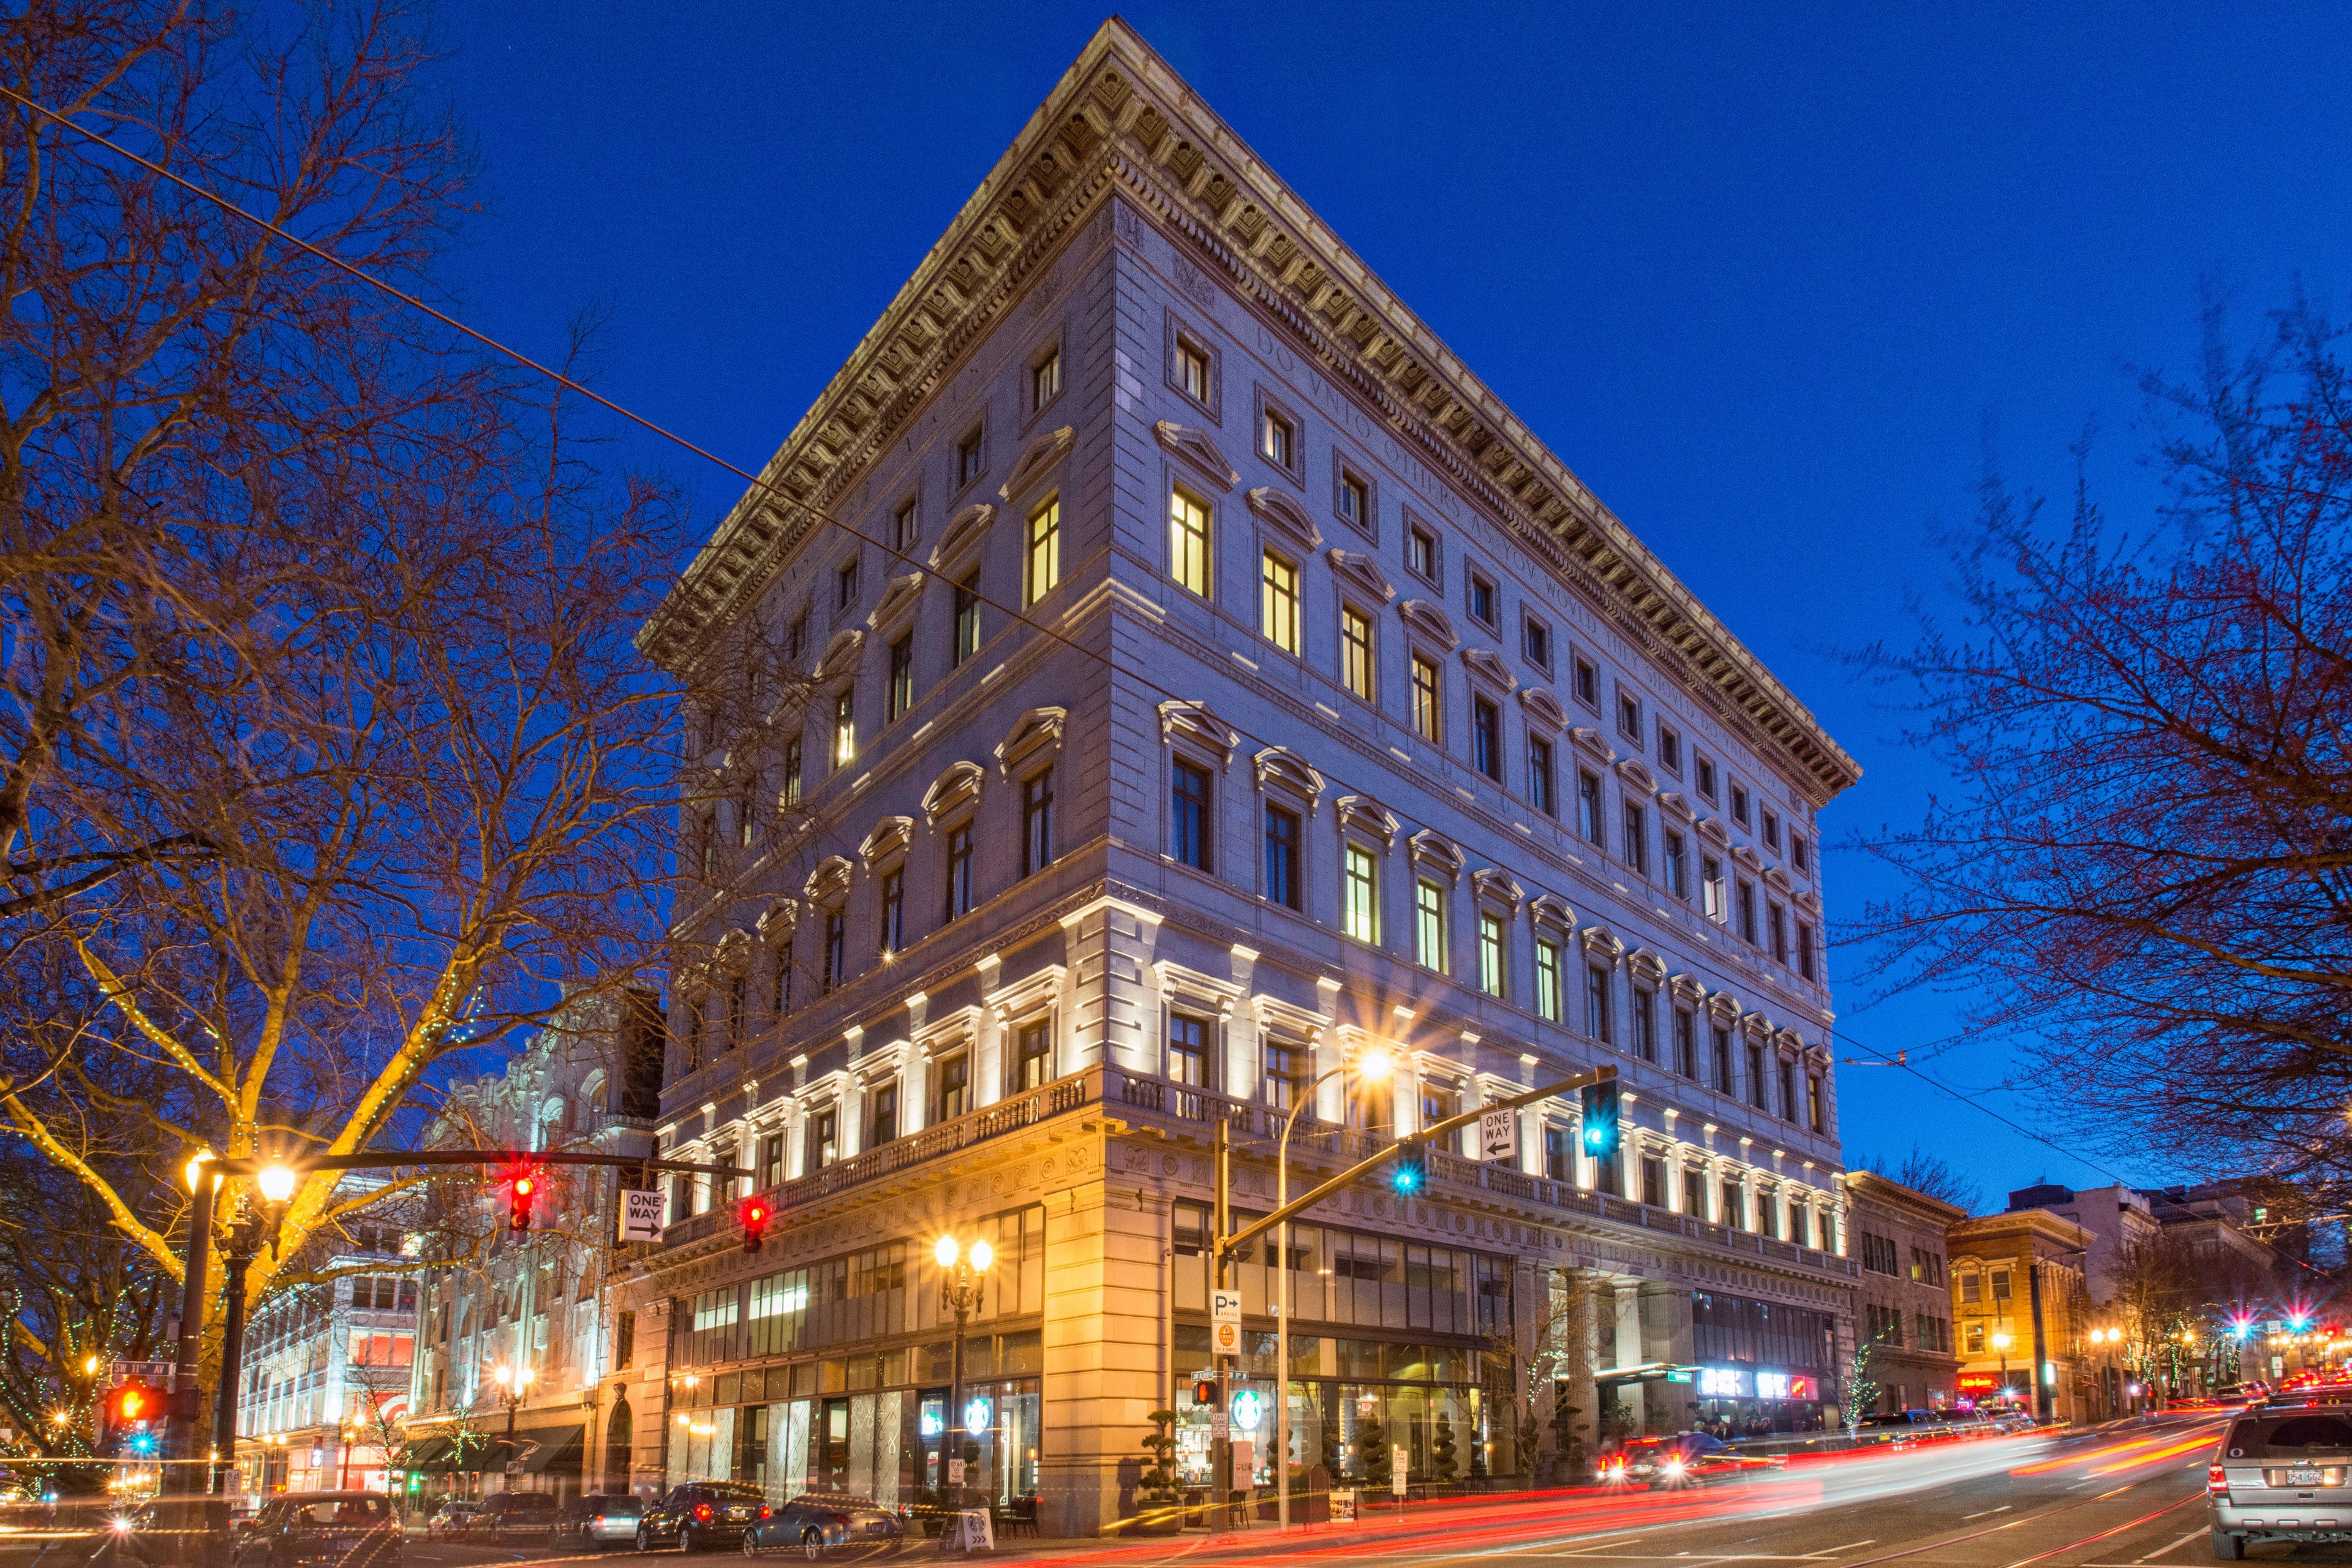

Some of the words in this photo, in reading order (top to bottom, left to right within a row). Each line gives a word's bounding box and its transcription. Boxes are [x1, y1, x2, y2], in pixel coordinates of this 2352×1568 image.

[1257, 327, 1292, 373] DO
[1487, 1112, 1509, 1127] ONE
[1486, 1125, 1510, 1140] WAY
[630, 1194, 661, 1207] ONE
[630, 1207, 661, 1219] WAY
[1608, 1246, 1642, 1265] TEMPLE
[115, 1363, 126, 1373] SW
[153, 1365, 165, 1374] AV
